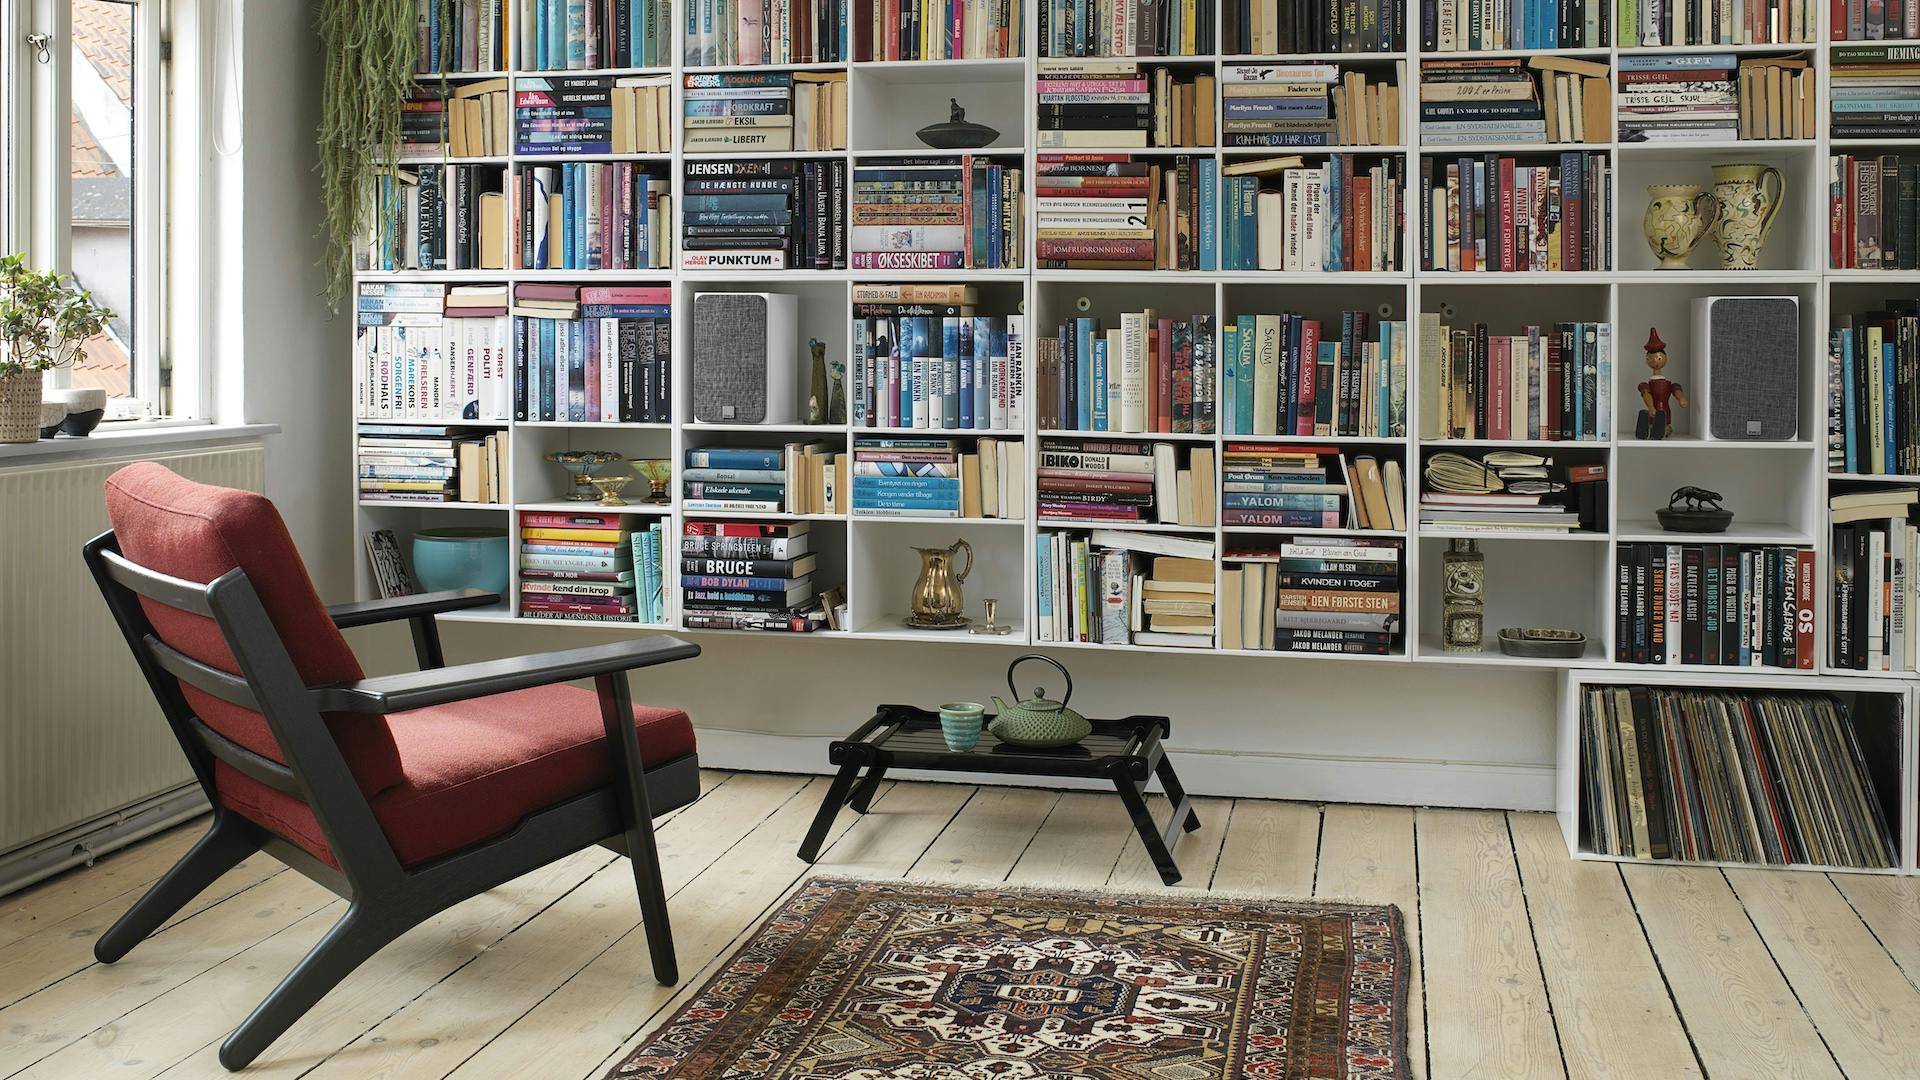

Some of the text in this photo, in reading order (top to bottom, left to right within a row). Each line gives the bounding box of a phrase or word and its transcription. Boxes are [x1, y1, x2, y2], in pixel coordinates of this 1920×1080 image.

[1443, 9, 1451, 36] AF GLAS
[1675, 57, 1712, 65] GIFT
[734, 117, 756, 126] EKSIL
[733, 136, 766, 144] LIBERTY
[1272, 135, 1283, 144] DU
[1860, 165, 1869, 215] HISTORIEN
[1517, 187, 1527, 224] NYNNES
[420, 190, 429, 242] VALERIA
[1128, 216, 1146, 226] 2
[1305, 207, 1314, 220] med
[1504, 215, 1511, 225] AT
[818, 238, 827, 255] LUKA
[708, 256, 772, 265] PUNKTUM
[877, 252, 940, 268] ØKSESKIBET
[886, 290, 898, 298] FALD
[1010, 342, 1015, 351] EN
[1195, 344, 1203, 357] DE
[1243, 328, 1252, 365] SARUM
[1264, 328, 1275, 365] SARUM
[1304, 329, 1313, 394] ISLANDSKE SAGAER
[1833, 347, 1841, 376] BOGEN
[381, 361, 389, 409] RØDHALS
[1340, 370, 1349, 399] PERSEPOLIS
[1351, 370, 1360, 399] PERSEPOLIS
[1045, 454, 1078, 468] BIKO
[704, 486, 729, 494] Elskede
[1242, 496, 1284, 507] YALOM
[1240, 514, 1282, 524] YALOM
[684, 540, 761, 552] BRUCE SPRINGSTEEN
[706, 560, 754, 575] BRUCE
[1339, 563, 1356, 572] OLSEN
[701, 578, 750, 587] BOB DYLAN
[1301, 578, 1341, 588] KVINDEN
[1348, 580, 1380, 588] TOGET
[1725, 568, 1736, 594] PIGEN OG
[1784, 555, 1796, 600] MORTEN
[1802, 563, 1810, 601] MORTEN SABROE
[522, 583, 551, 591] Kvinde
[552, 584, 573, 592] kend
[589, 586, 609, 595] krop
[1620, 565, 1628, 616] JAKOB MELANDER
[1636, 566, 1644, 617] JAKOB MELANDER
[1669, 562, 1680, 623] EVAS SIDSTE NAT
[1686, 565, 1698, 621] DJÆVLENS ANSIGT
[1311, 596, 1388, 610] DEN FØRSTE STEN
[1653, 569, 1664, 643] SKRIG UNDER VAND
[1707, 568, 1718, 632] DET NORSKE JOB
[1782, 601, 1796, 643] SABROE
[1798, 608, 1813, 633] OS
[1292, 630, 1343, 639] JAKOB MELANDER
[1292, 642, 1342, 650] JAKOB MELANDER
